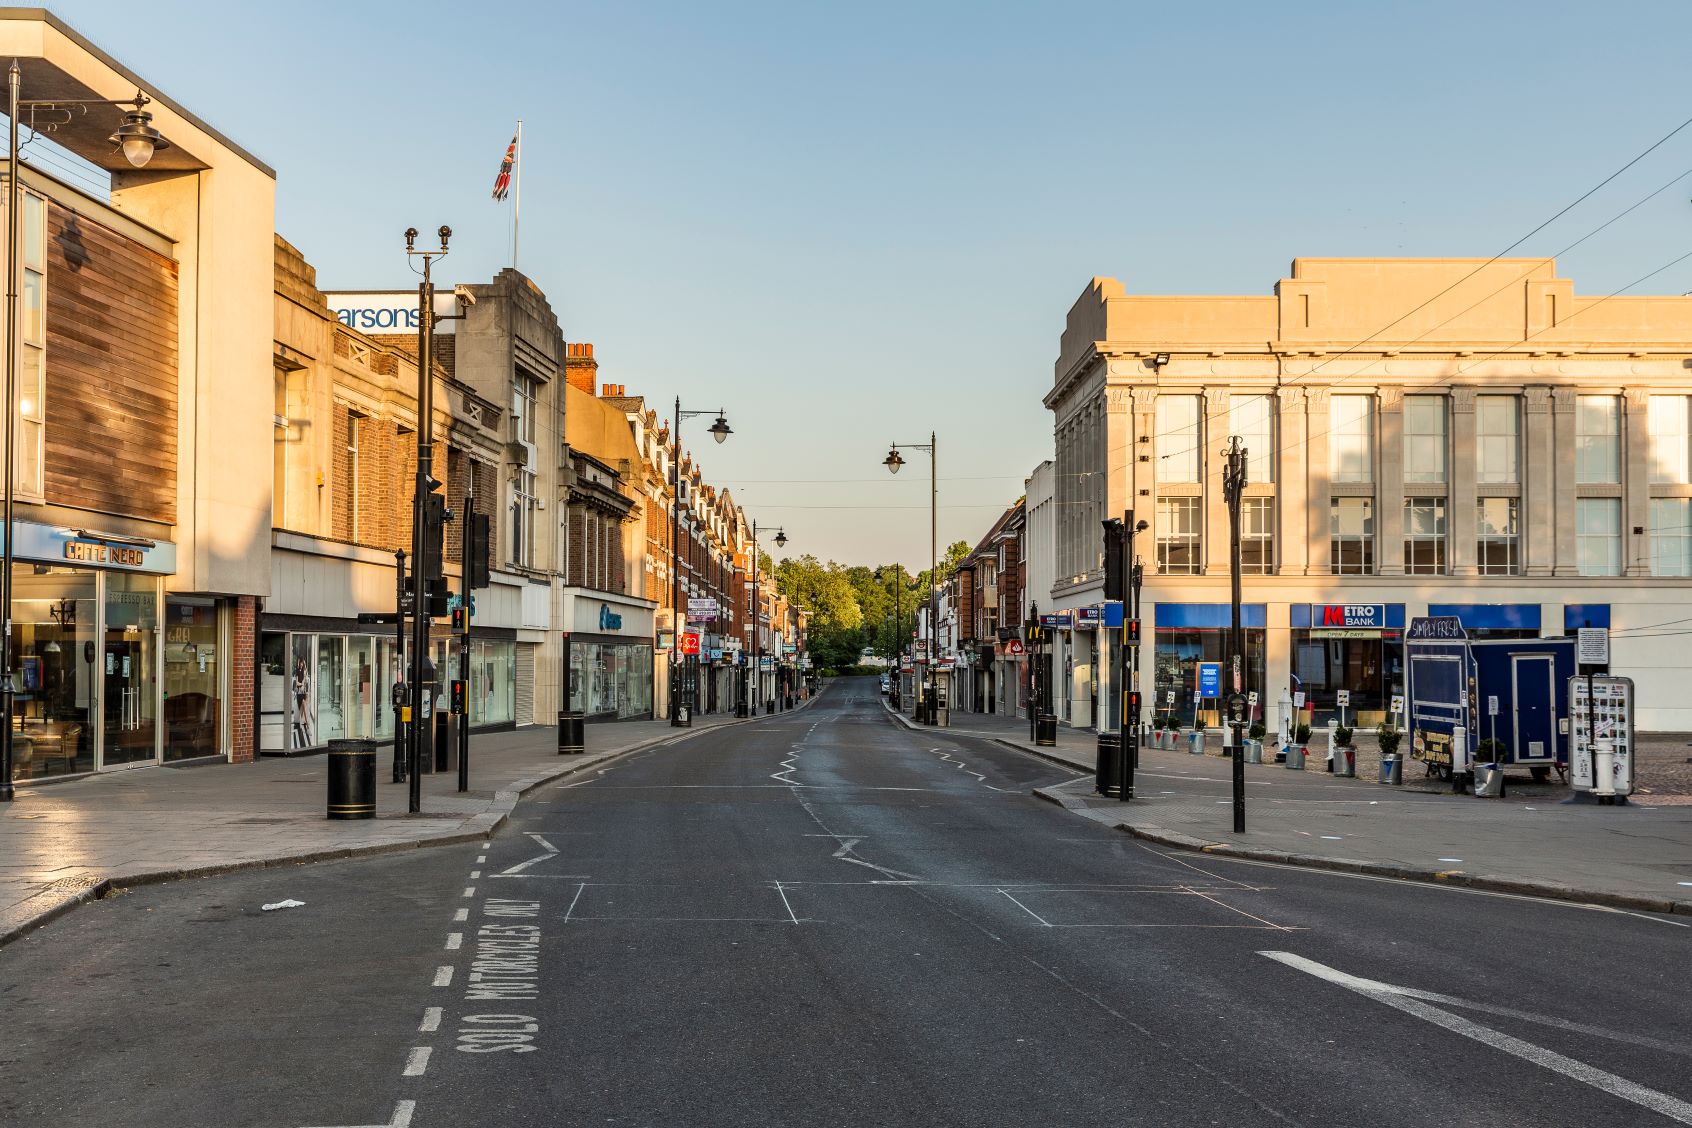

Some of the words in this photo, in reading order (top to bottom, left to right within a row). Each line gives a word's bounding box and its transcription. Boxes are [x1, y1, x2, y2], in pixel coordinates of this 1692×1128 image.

[327, 308, 419, 328] arsons
[109, 546, 144, 567] NERO
[109, 593, 140, 605] ESPRESSO
[143, 595, 154, 605] BAR
[1323, 605, 1375, 627] METRO
[1345, 617, 1375, 626] BANK
[1344, 630, 1349, 638] 7
[1412, 620, 1436, 637] SIMPLY
[1437, 620, 1459, 637] FRESH
[482, 898, 541, 917] ONLY
[464, 924, 542, 1000] MOTORCYCLES
[456, 1014, 541, 1053] SOLO
